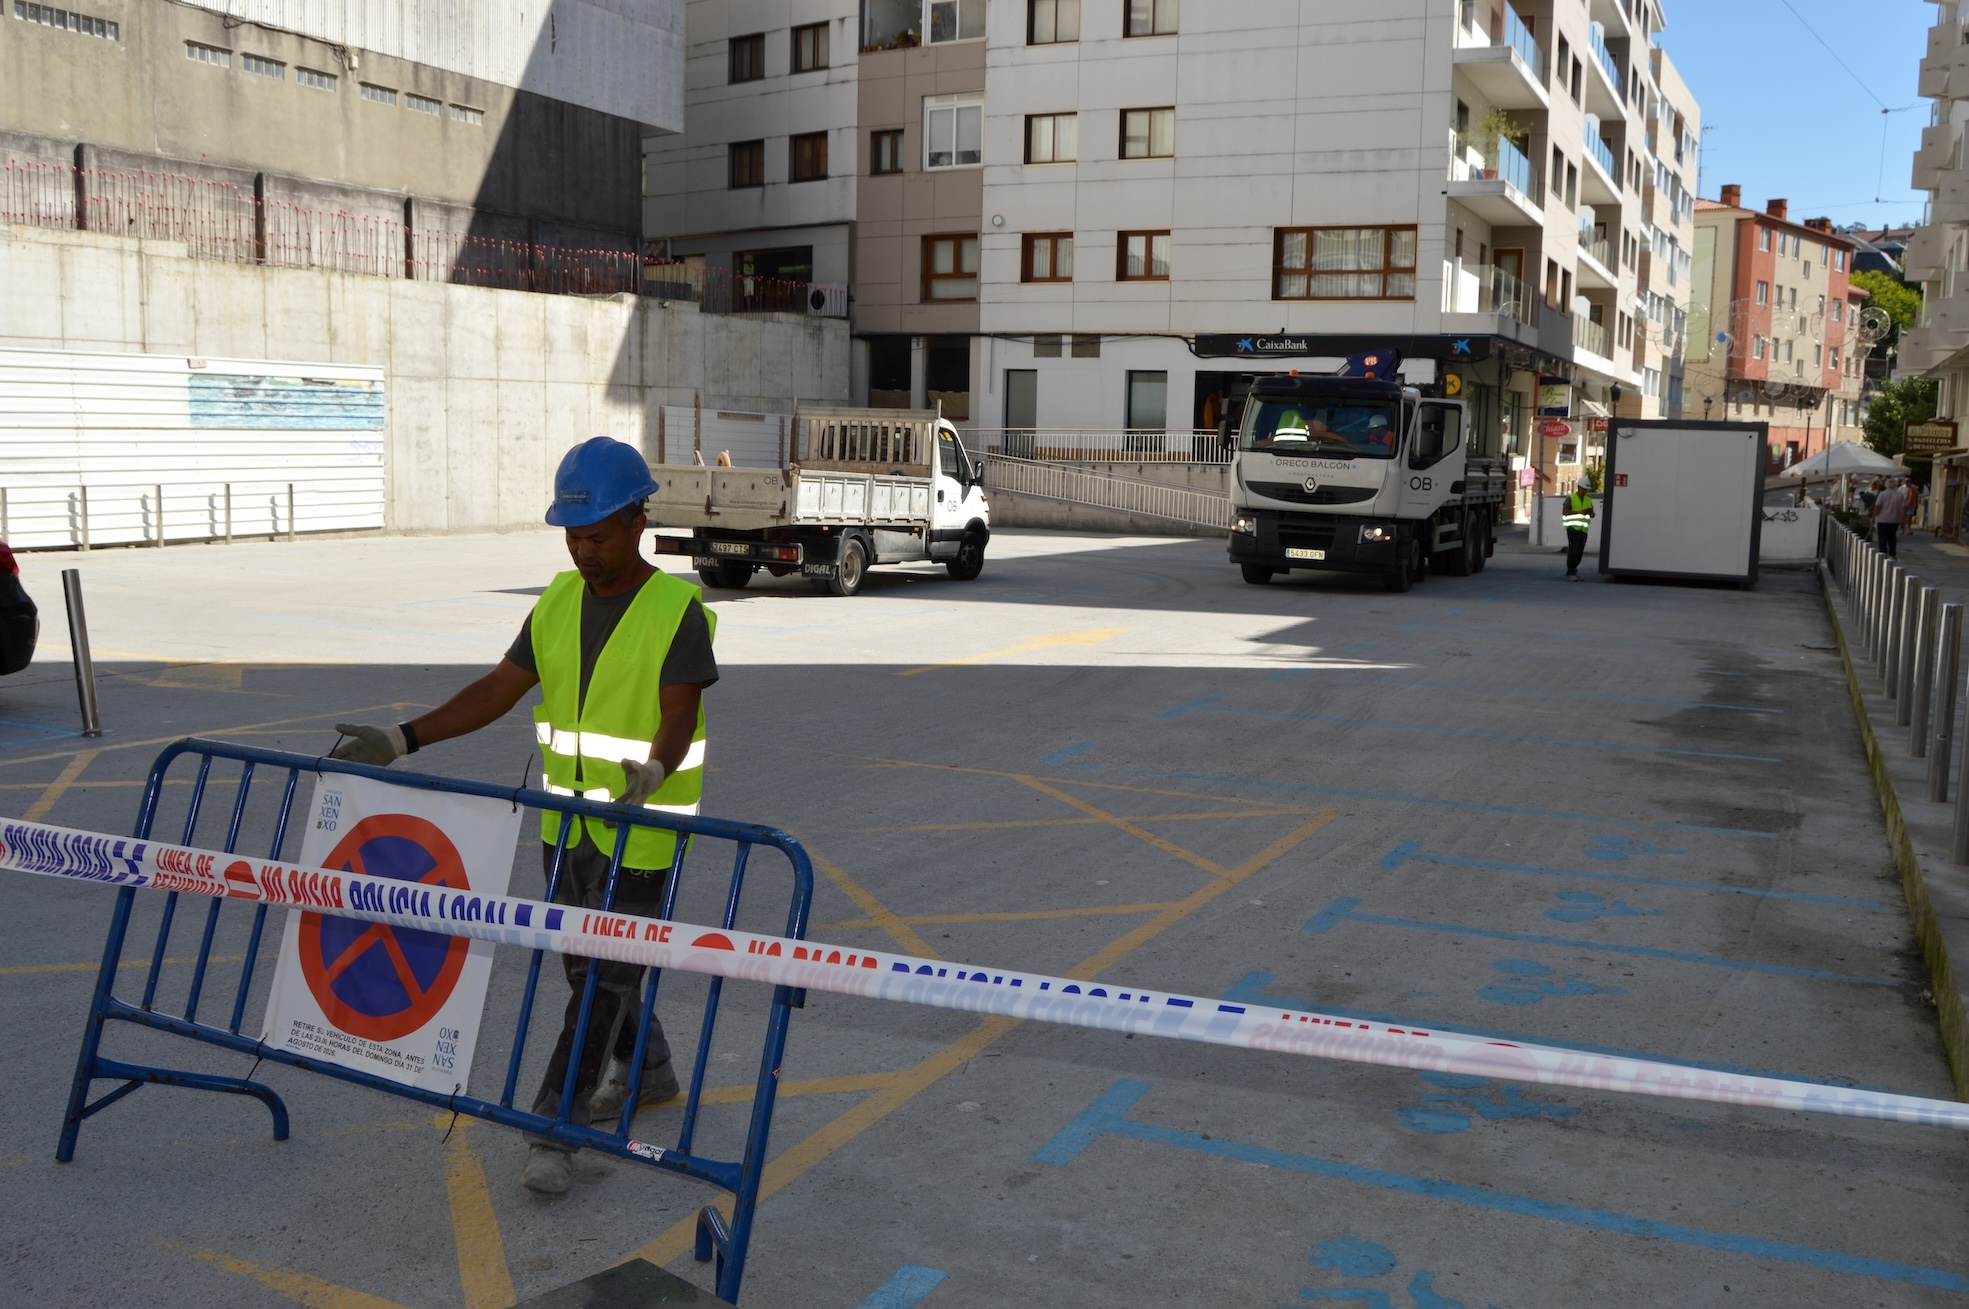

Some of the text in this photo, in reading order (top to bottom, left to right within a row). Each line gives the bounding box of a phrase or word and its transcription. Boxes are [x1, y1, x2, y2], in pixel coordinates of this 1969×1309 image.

[1256, 338, 1309, 351] CaixaBank
[1540, 423, 1567, 433] hiara
[1275, 458, 1351, 470] ORECO BALGÓN
[764, 475, 779, 486] OB
[1409, 476, 1432, 491] OB
[947, 500, 958, 512] OB
[713, 542, 732, 552] 2497
[733, 544, 750, 554] CTS
[1290, 549, 1308, 558] 5433
[693, 556, 720, 568] DIGAL
[804, 564, 831, 576] DIGAL
[322, 794, 343, 808] SAN
[319, 806, 340, 820] XEN
[4, 824, 120, 882] POLICIA LOCAL
[156, 847, 215, 880] LINEA DE
[260, 865, 288, 903] NO
[287, 1037, 314, 1050] AGOSTO
[314, 1044, 323, 1053] DE
[291, 1028, 301, 1037] DE
[301, 1032, 314, 1041] LAS
[329, 1040, 351, 1052] HORAS
[352, 1046, 364, 1057] DEL
[365, 1050, 393, 1065] DOMINGO
[293, 1020, 316, 1032] RETIRE
[317, 1027, 326, 1035] SU
[358, 1039, 367, 1048] DE
[369, 1042, 383, 1053] ESTA
[384, 1047, 402, 1060] ZONA,
[405, 1054, 425, 1065] ANTES
[435, 1040, 458, 1056] XEN
[432, 1053, 455, 1069] SAN
